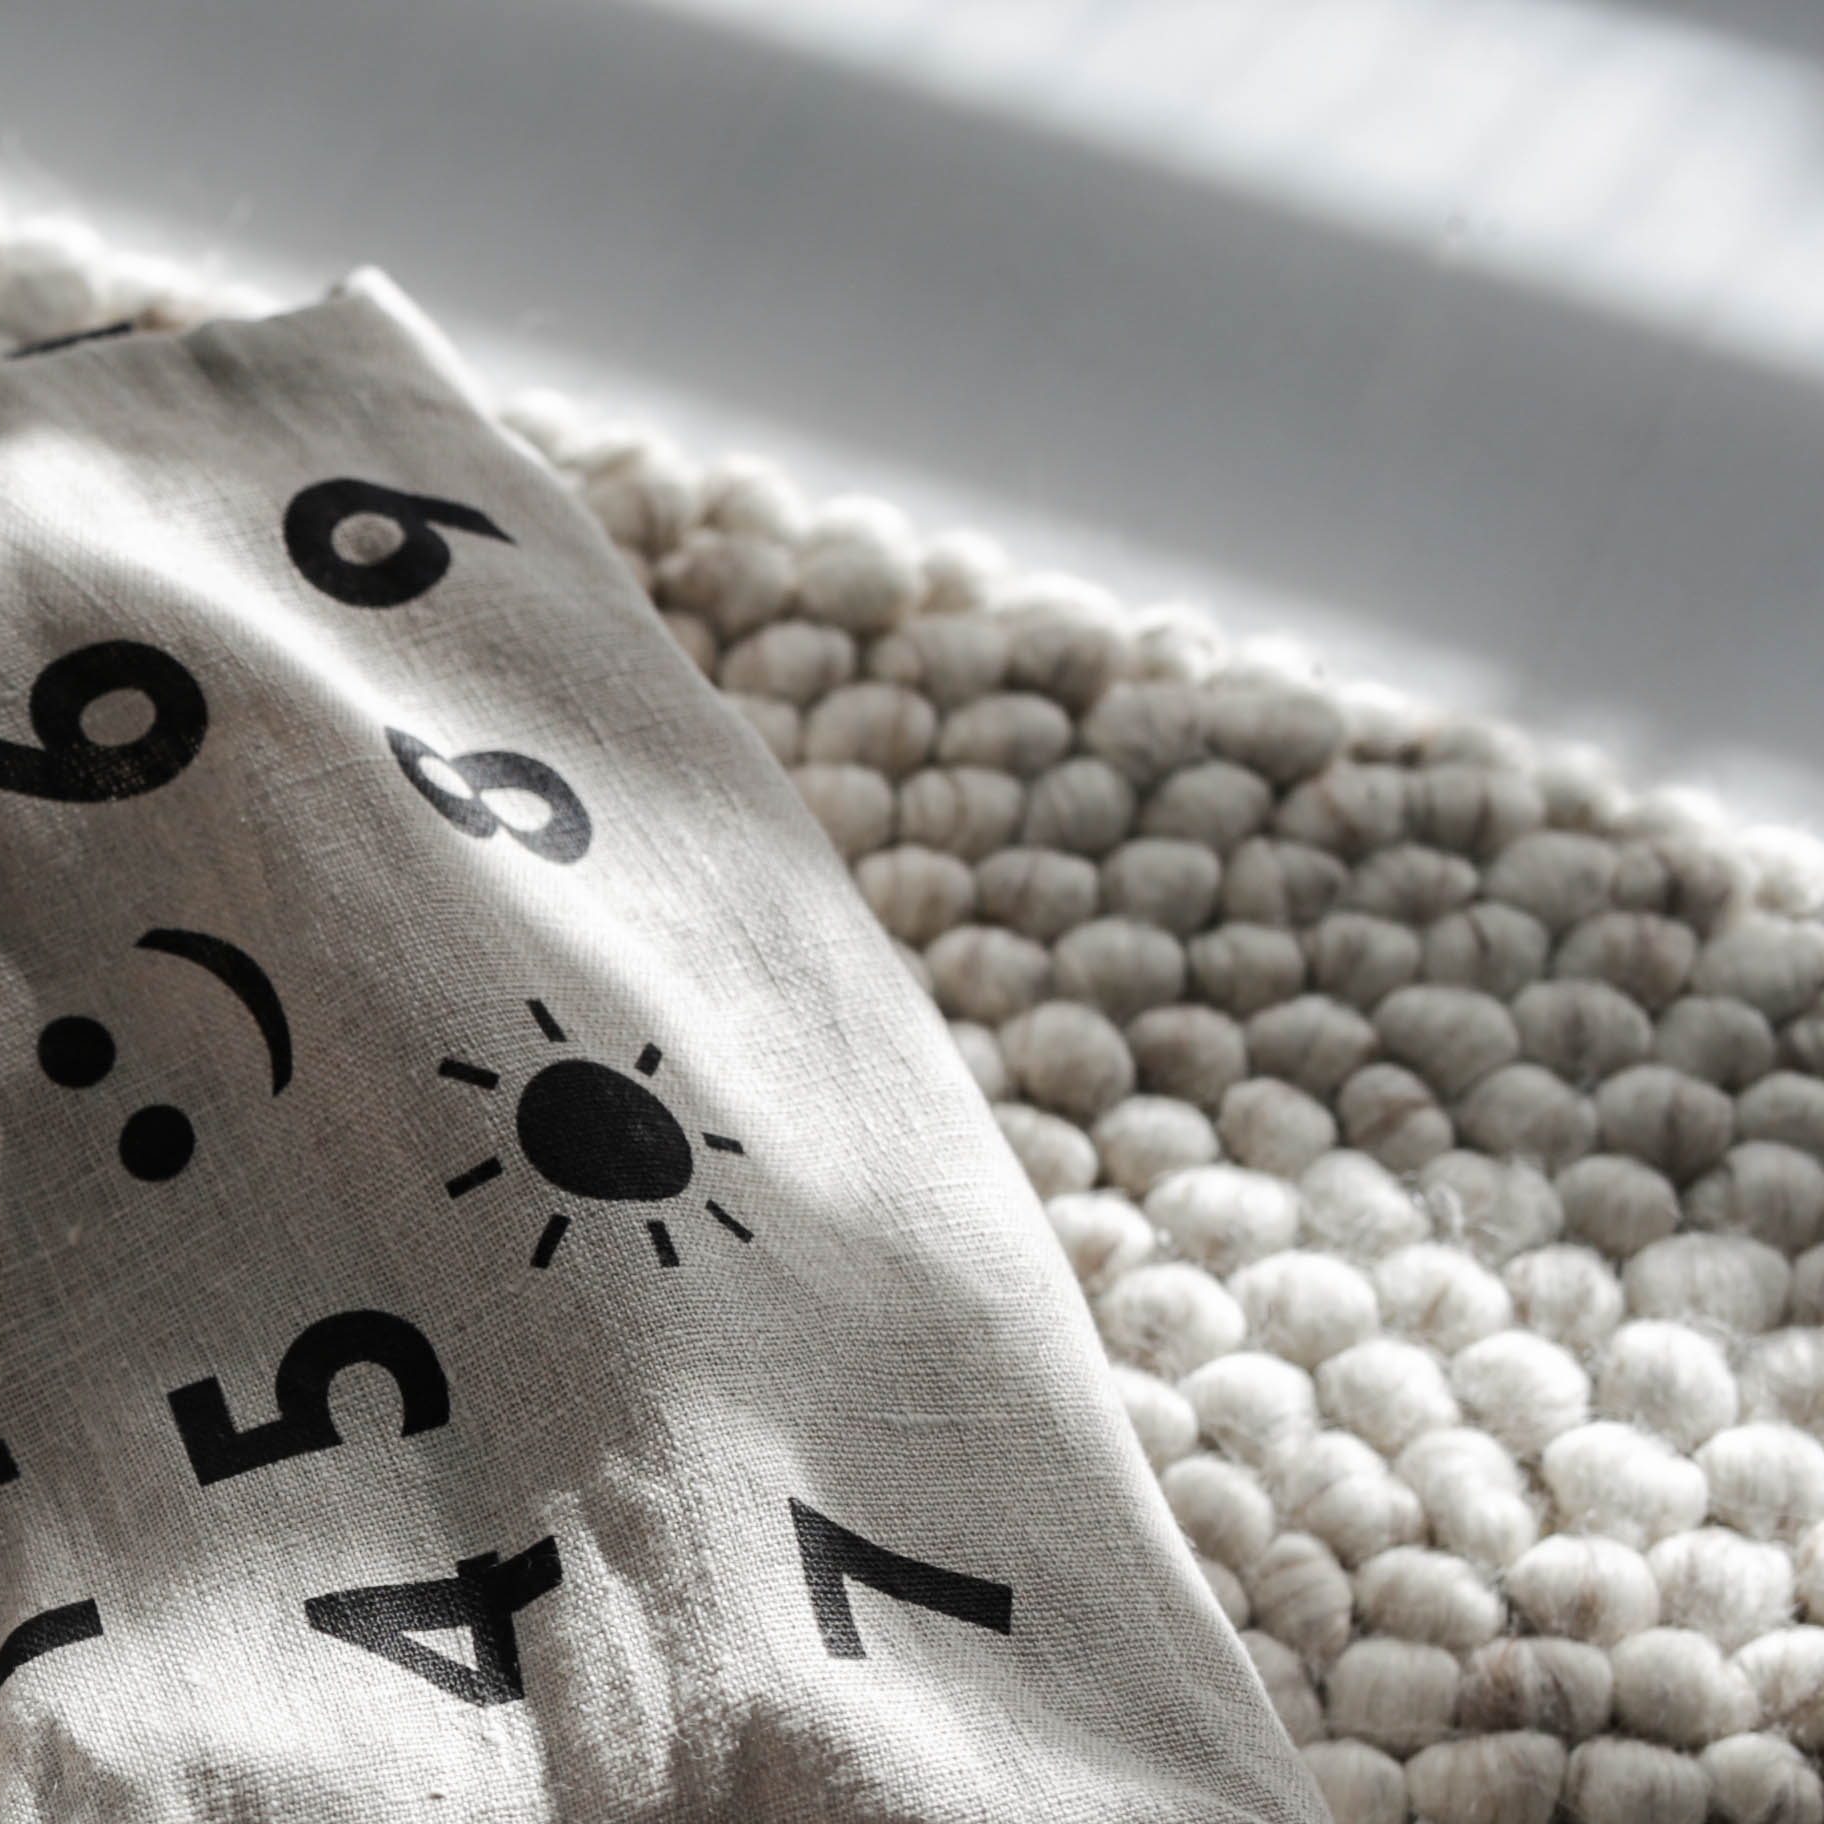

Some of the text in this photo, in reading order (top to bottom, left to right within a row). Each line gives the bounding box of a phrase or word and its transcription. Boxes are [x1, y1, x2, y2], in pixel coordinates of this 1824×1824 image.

[386, 725, 592, 865] 8
[168, 1309, 452, 1485] 5
[305, 1533, 564, 1707] 4
[787, 1496, 1014, 1659] 7
